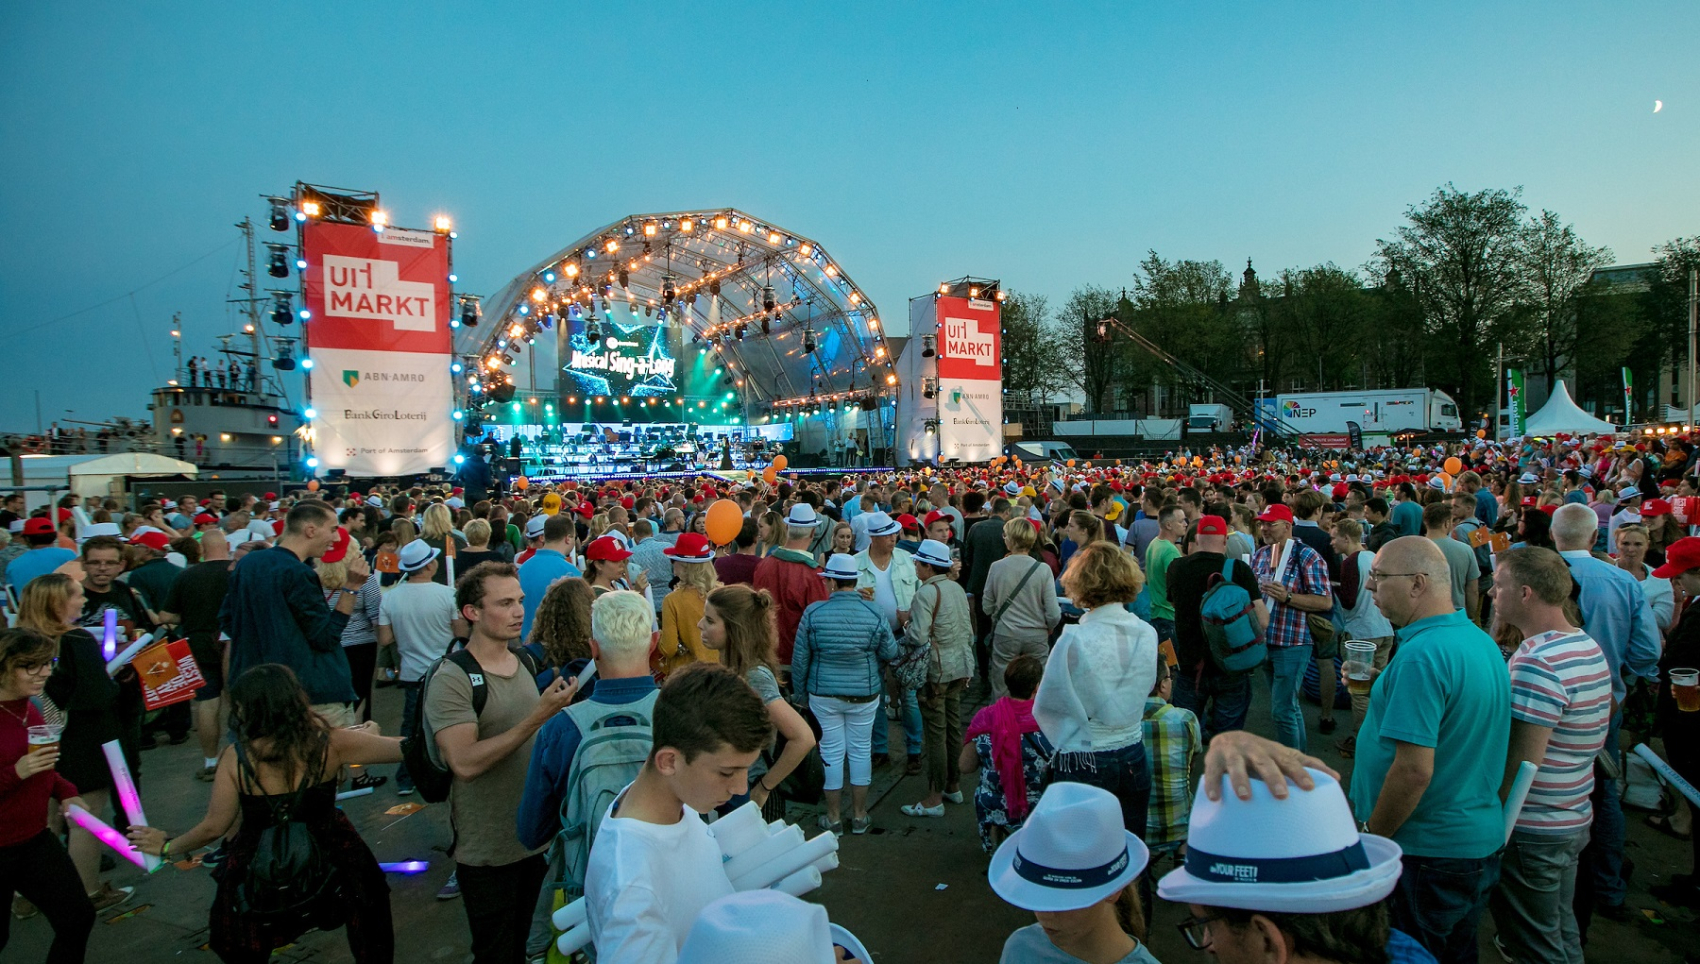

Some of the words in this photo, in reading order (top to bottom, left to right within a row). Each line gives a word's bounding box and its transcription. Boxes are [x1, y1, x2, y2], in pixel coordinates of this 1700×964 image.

[330, 290, 429, 317] MARKT
[948, 340, 992, 357] MARKT
[571, 350, 608, 370] Musical
[344, 409, 427, 421] BankGiroLoterij
[1293, 408, 1317, 418] NEP
[177, 654, 204, 683] WEST
